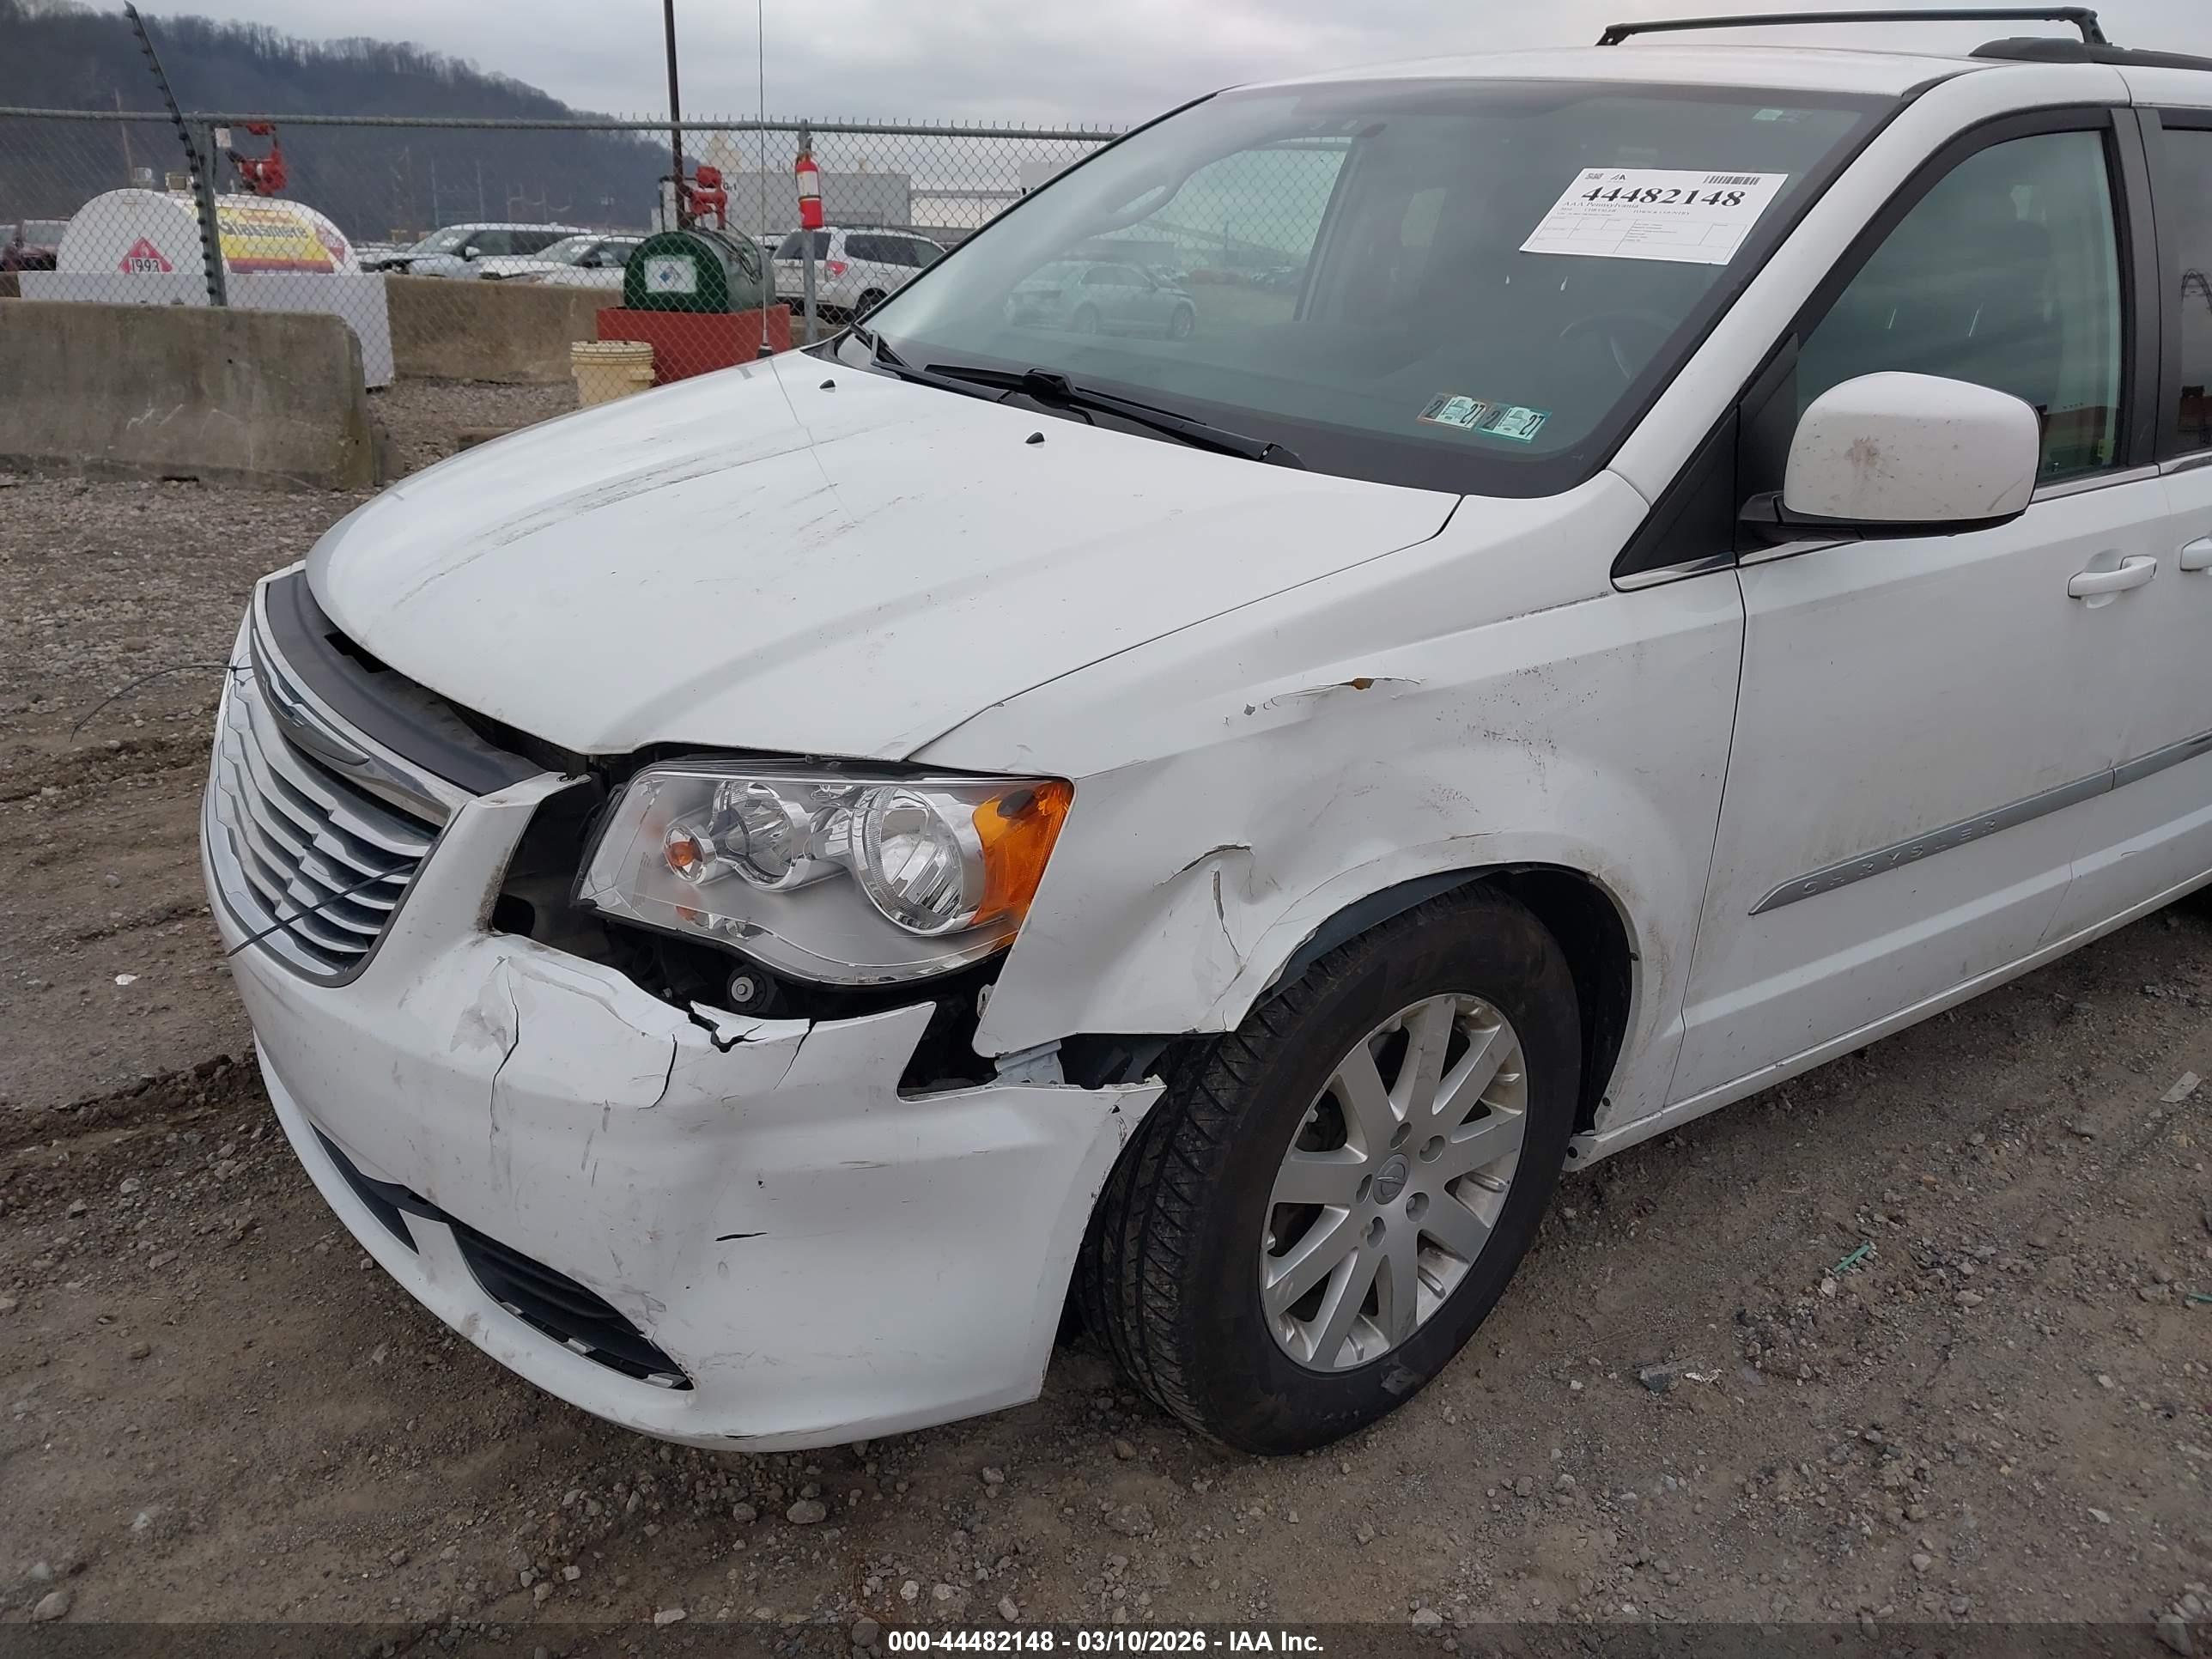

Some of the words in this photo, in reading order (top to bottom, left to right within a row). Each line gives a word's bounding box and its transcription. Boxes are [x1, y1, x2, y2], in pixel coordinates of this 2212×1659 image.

[1582, 185, 1746, 207] 44482148
[131, 259, 160, 273] 1993
[1459, 403, 1486, 427] 27
[1518, 414, 1545, 438] 27
[1802, 818, 1998, 896] CHRYSLER
